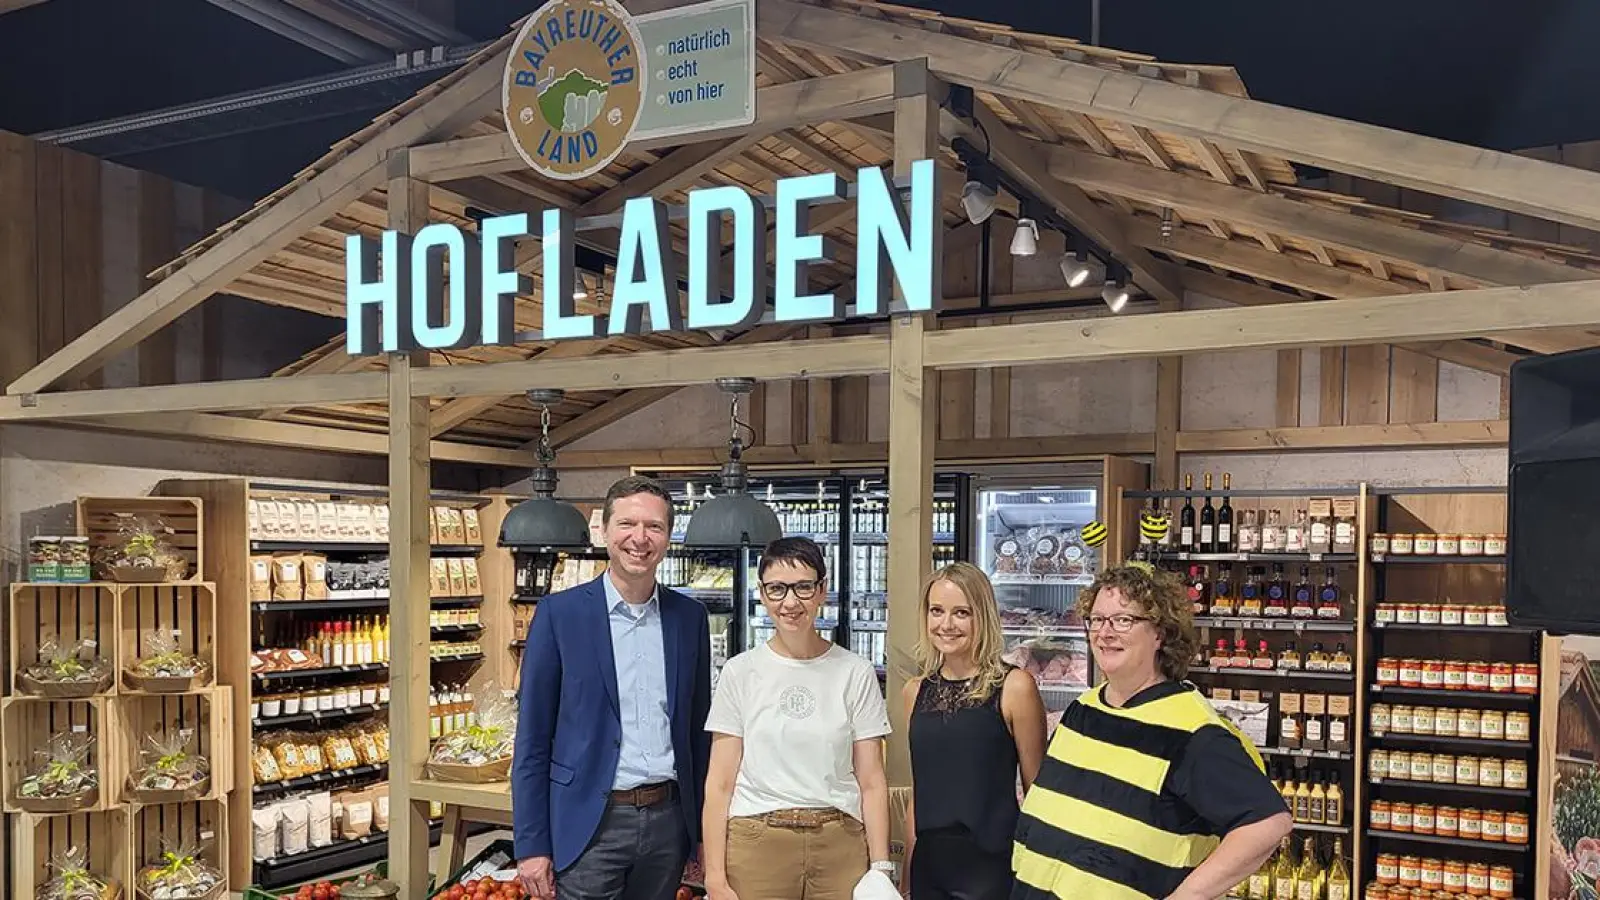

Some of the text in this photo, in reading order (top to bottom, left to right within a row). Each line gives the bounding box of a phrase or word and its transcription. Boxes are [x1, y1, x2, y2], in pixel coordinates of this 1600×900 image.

[515, 9, 634, 87] BAYREUTHER
[668, 28, 731, 55] natürlich
[668, 60, 698, 80] echt
[668, 81, 725, 105] von hier
[537, 130, 598, 164] LAND
[346, 159, 934, 355] HOFLADEN
